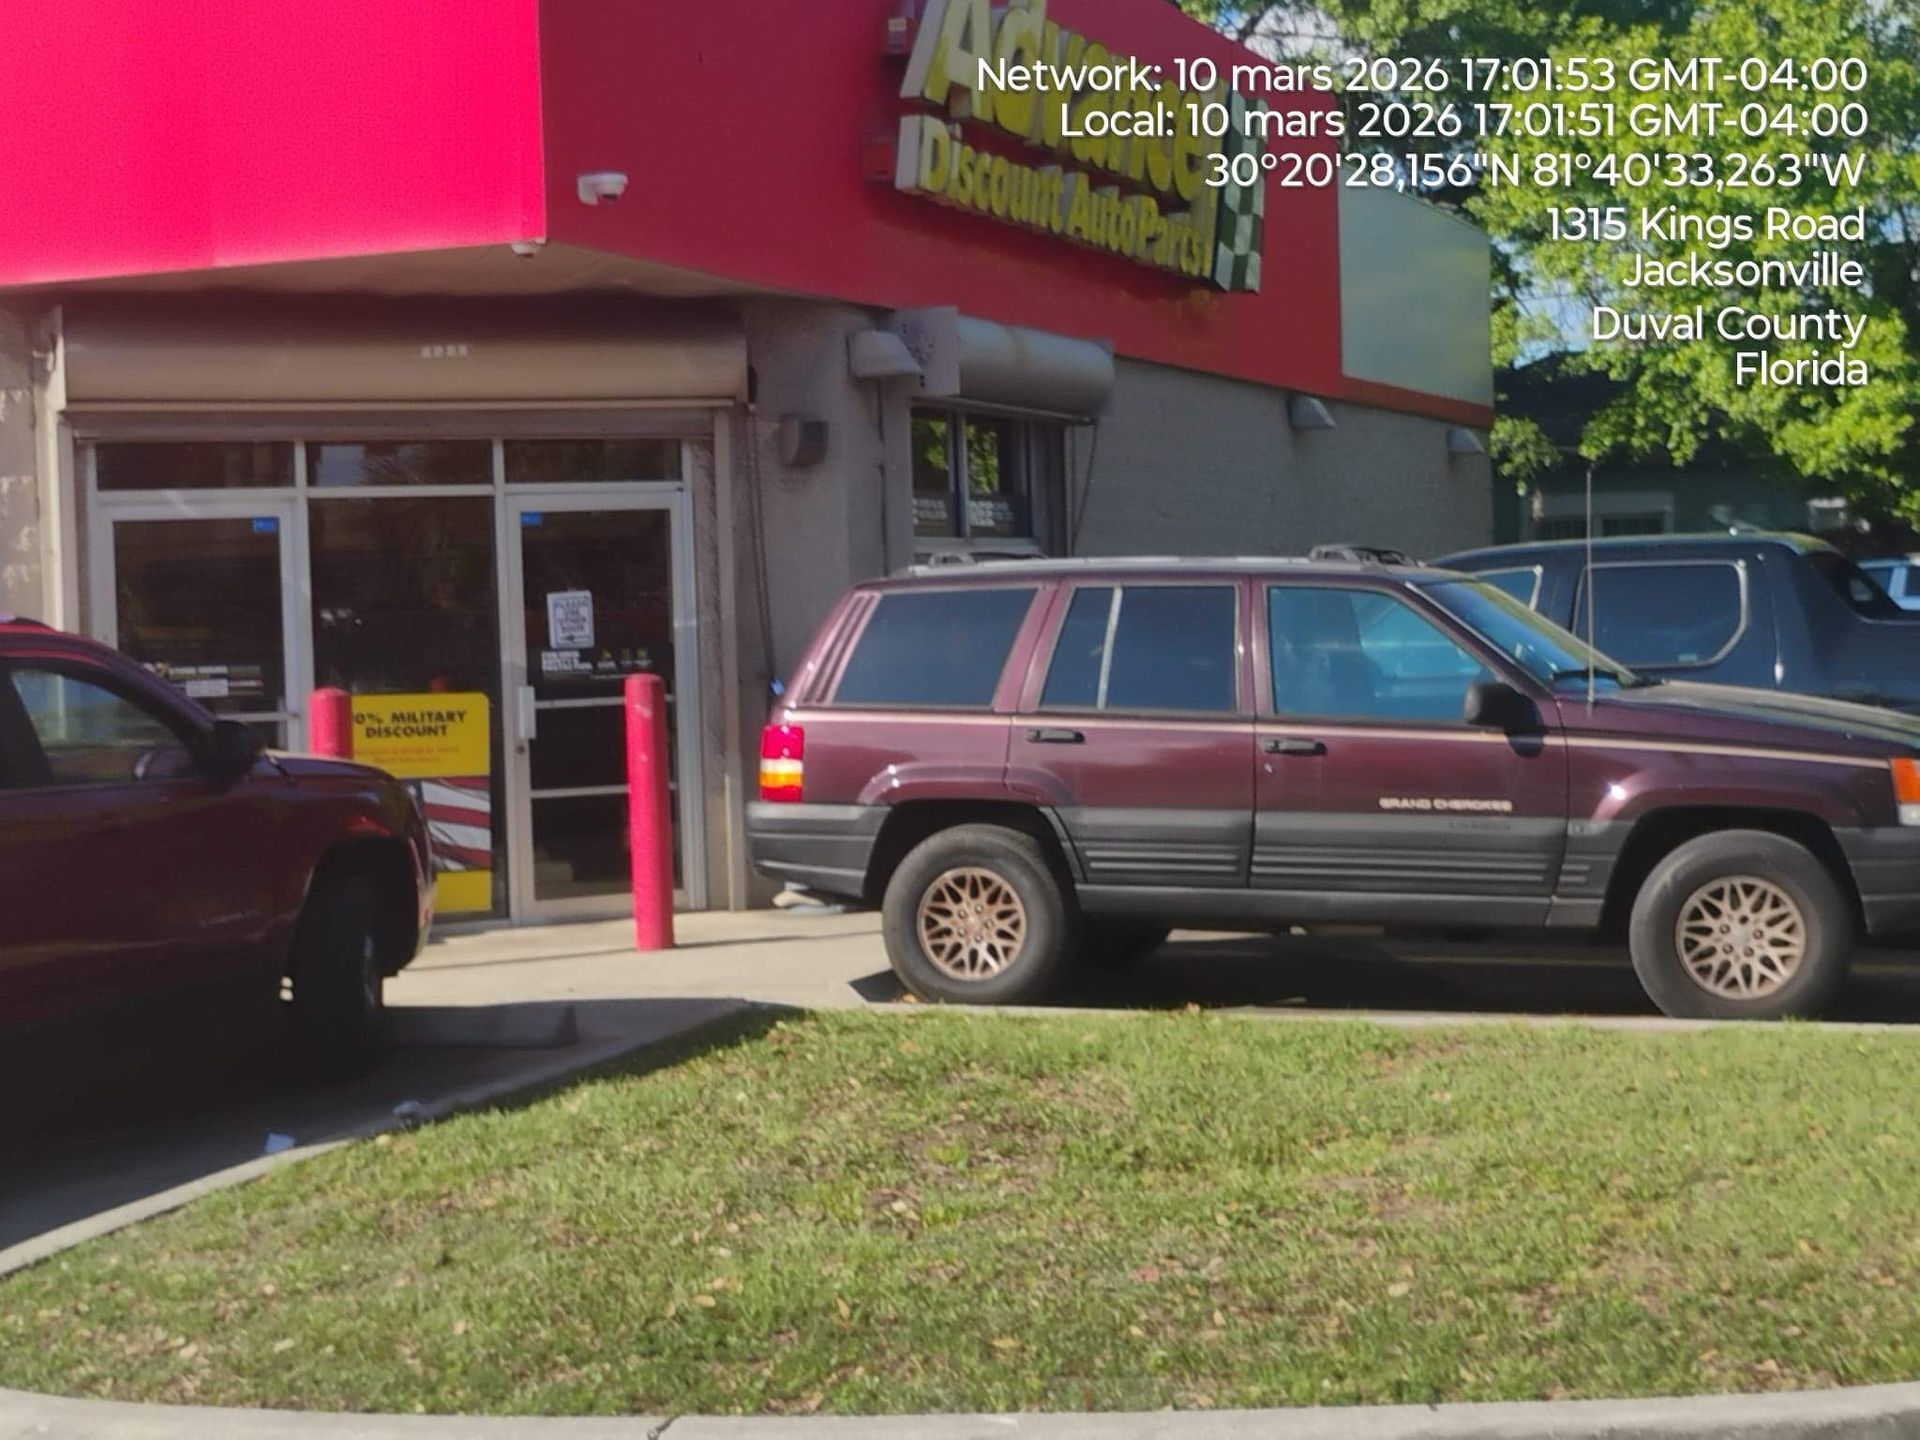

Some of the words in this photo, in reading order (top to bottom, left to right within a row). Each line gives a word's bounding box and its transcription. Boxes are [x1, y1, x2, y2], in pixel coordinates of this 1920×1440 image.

[910, 112, 1063, 234] Discount
[353, 712, 384, 725] 0%
[391, 709, 466, 724] MILITARY
[365, 724, 449, 739] DISCOUNT
